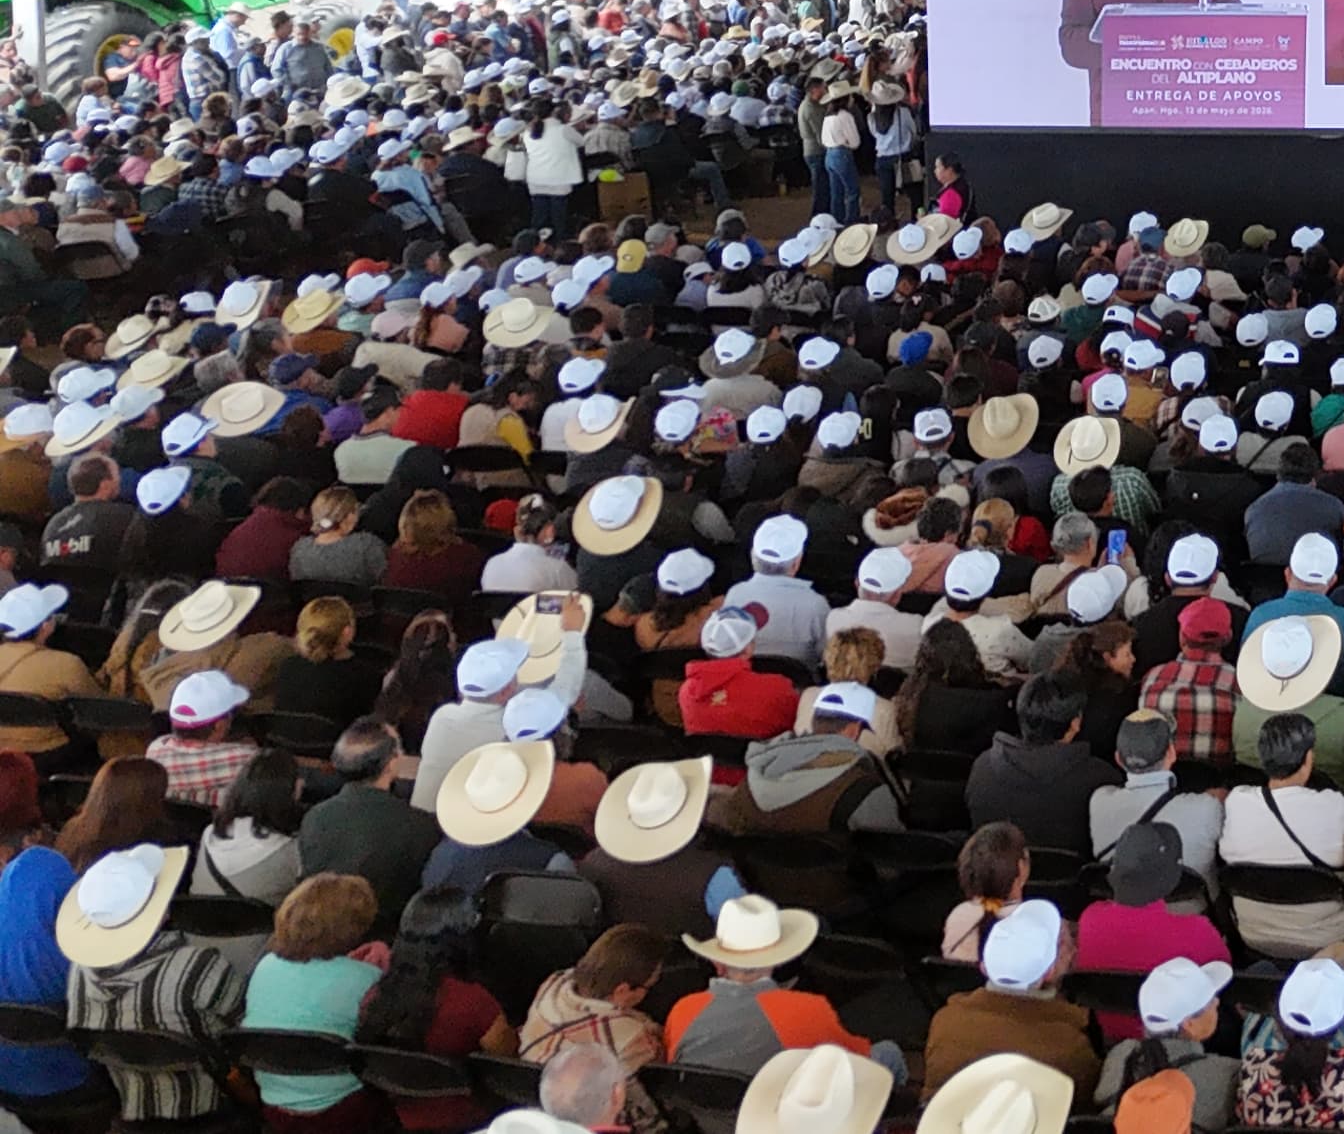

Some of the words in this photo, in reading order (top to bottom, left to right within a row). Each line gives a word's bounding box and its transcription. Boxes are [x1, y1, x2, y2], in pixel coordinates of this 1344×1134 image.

[1110, 58, 1192, 71] ENCUENTRO
[1193, 61, 1213, 71] CON
[1215, 58, 1298, 71] CEBADEROS
[1151, 74, 1171, 84] DEL
[1177, 71, 1256, 84] ALTIPLANO
[1126, 90, 1192, 101] ENTREGA
[1199, 91, 1217, 101] DE
[1223, 90, 1282, 101] APOYOS
[45, 535, 92, 557] Mobil
